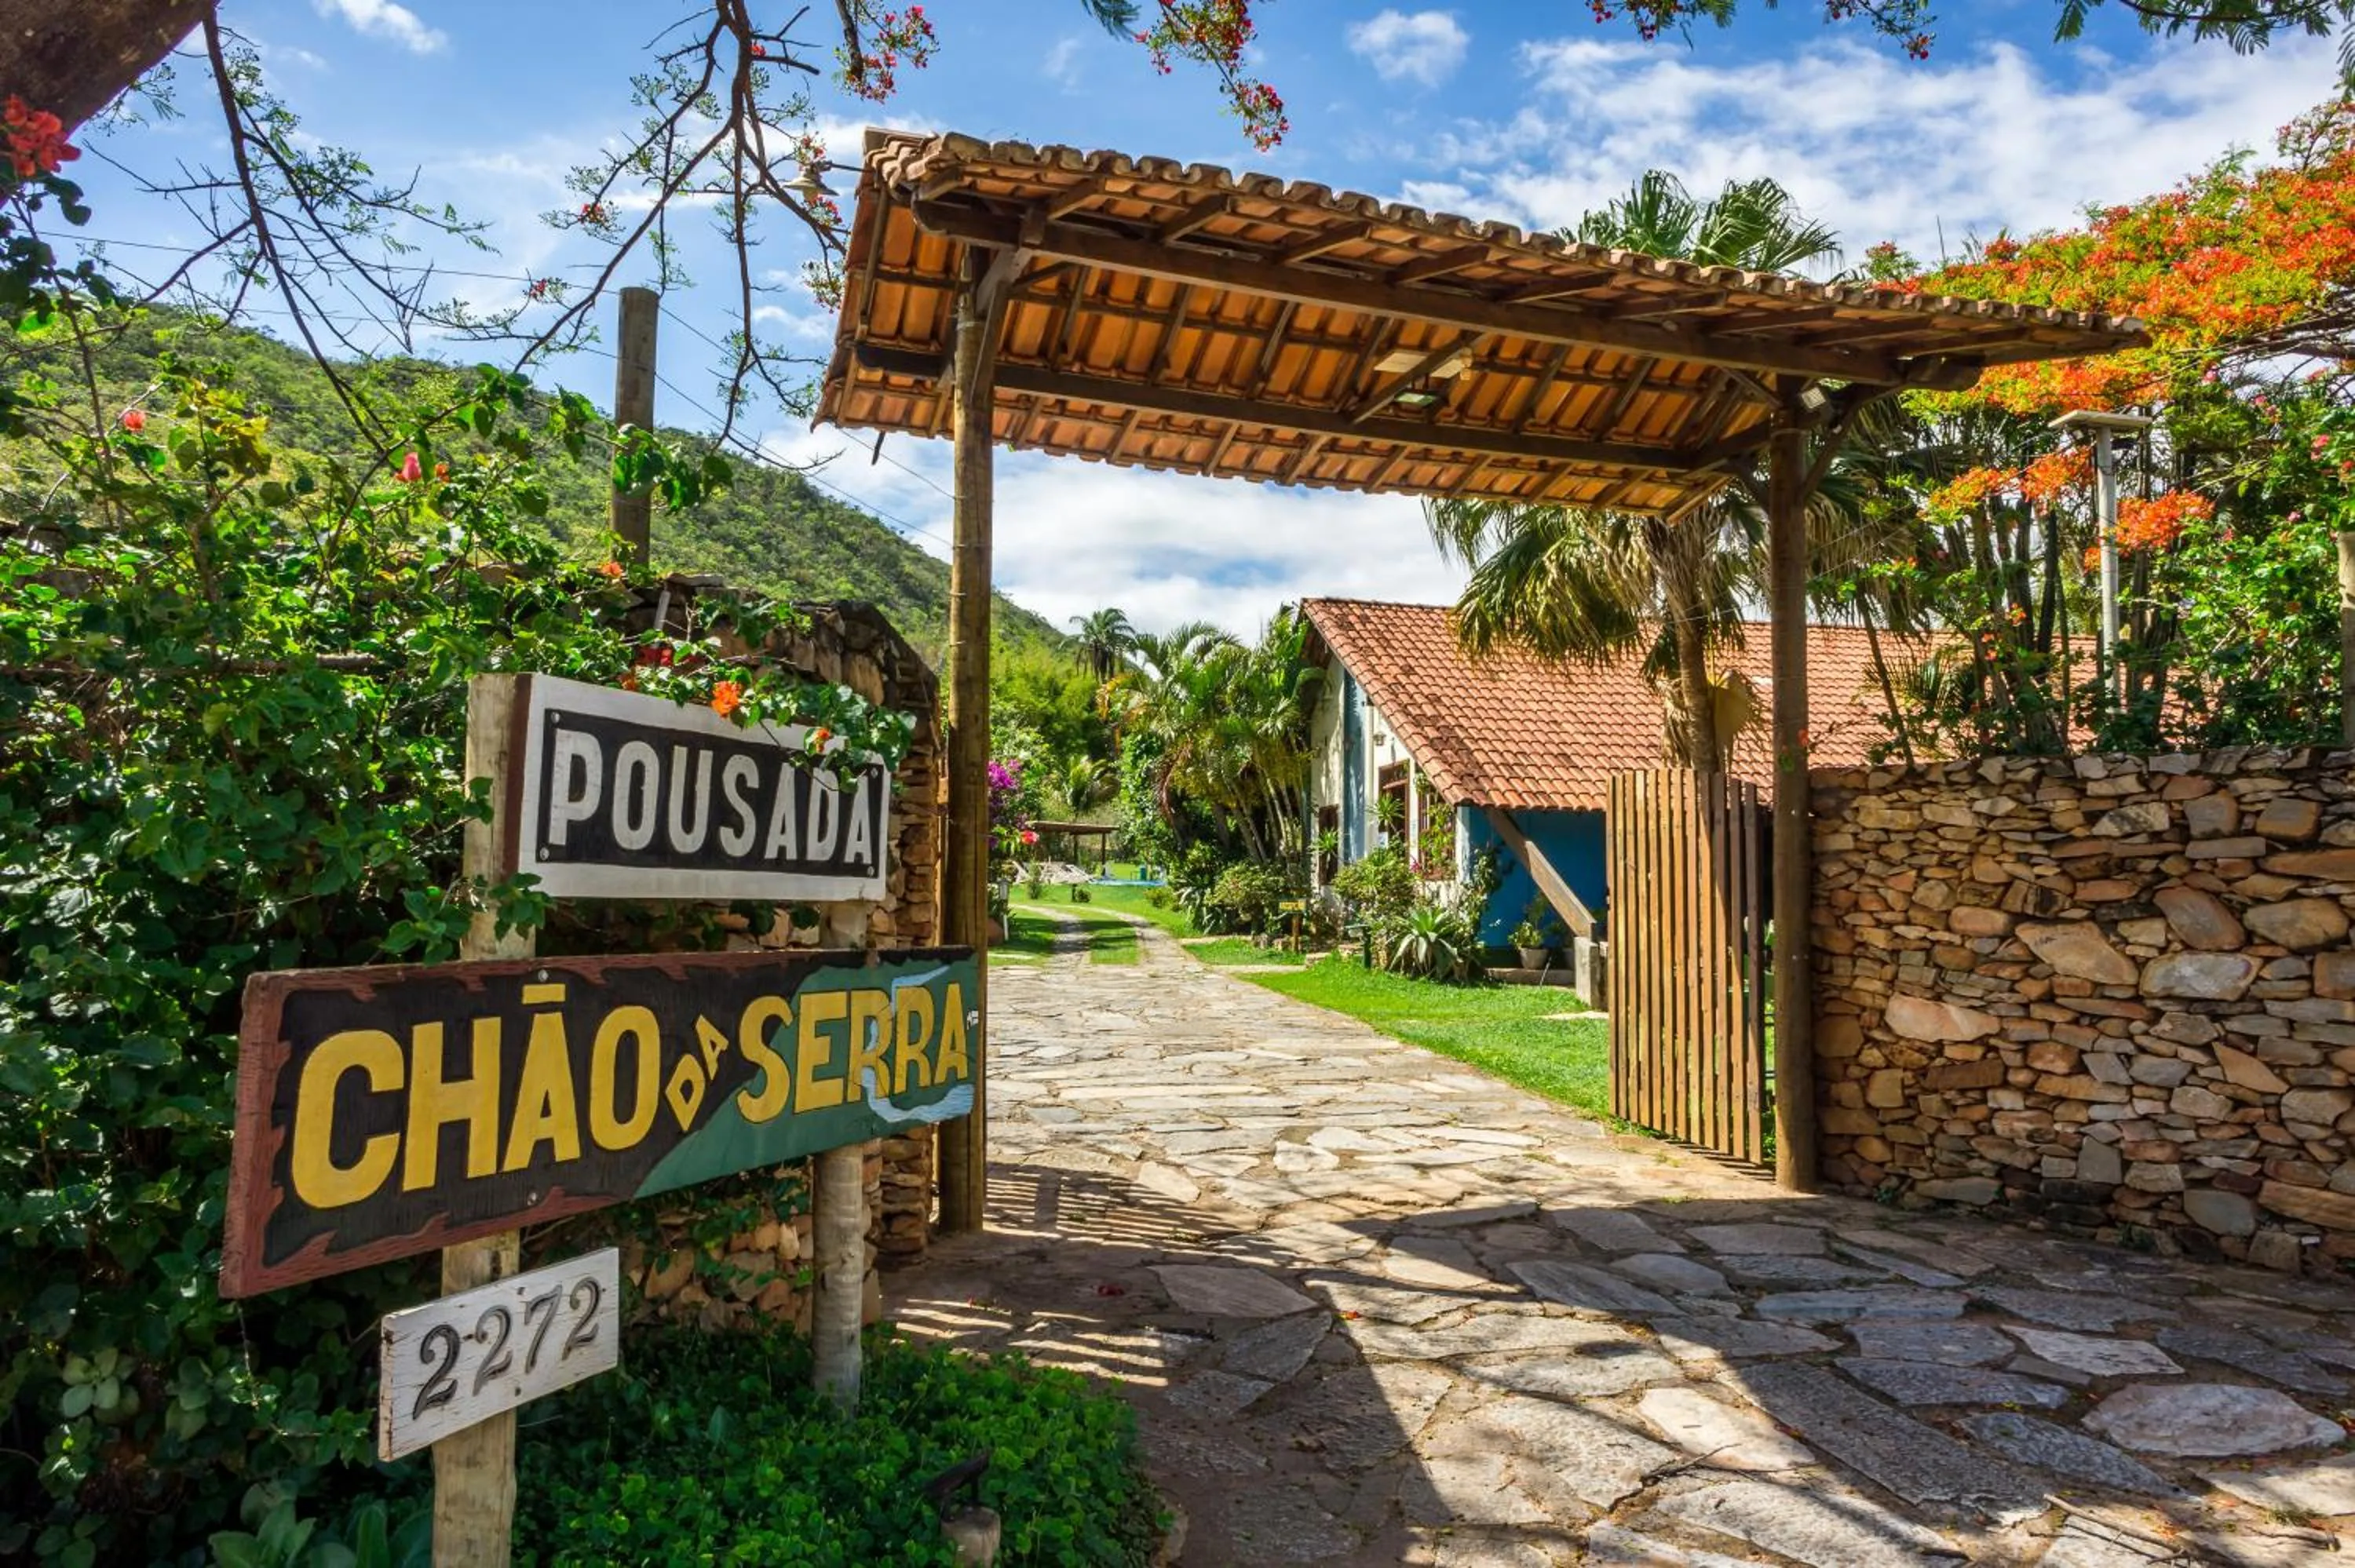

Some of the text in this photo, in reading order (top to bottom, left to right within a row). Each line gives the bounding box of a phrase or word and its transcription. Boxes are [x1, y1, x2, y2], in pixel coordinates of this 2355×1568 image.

[548, 727, 873, 865] POUSADA
[665, 1015, 728, 1132] DA
[737, 983, 969, 1124] SERRA
[412, 1276, 601, 1421] 2272
